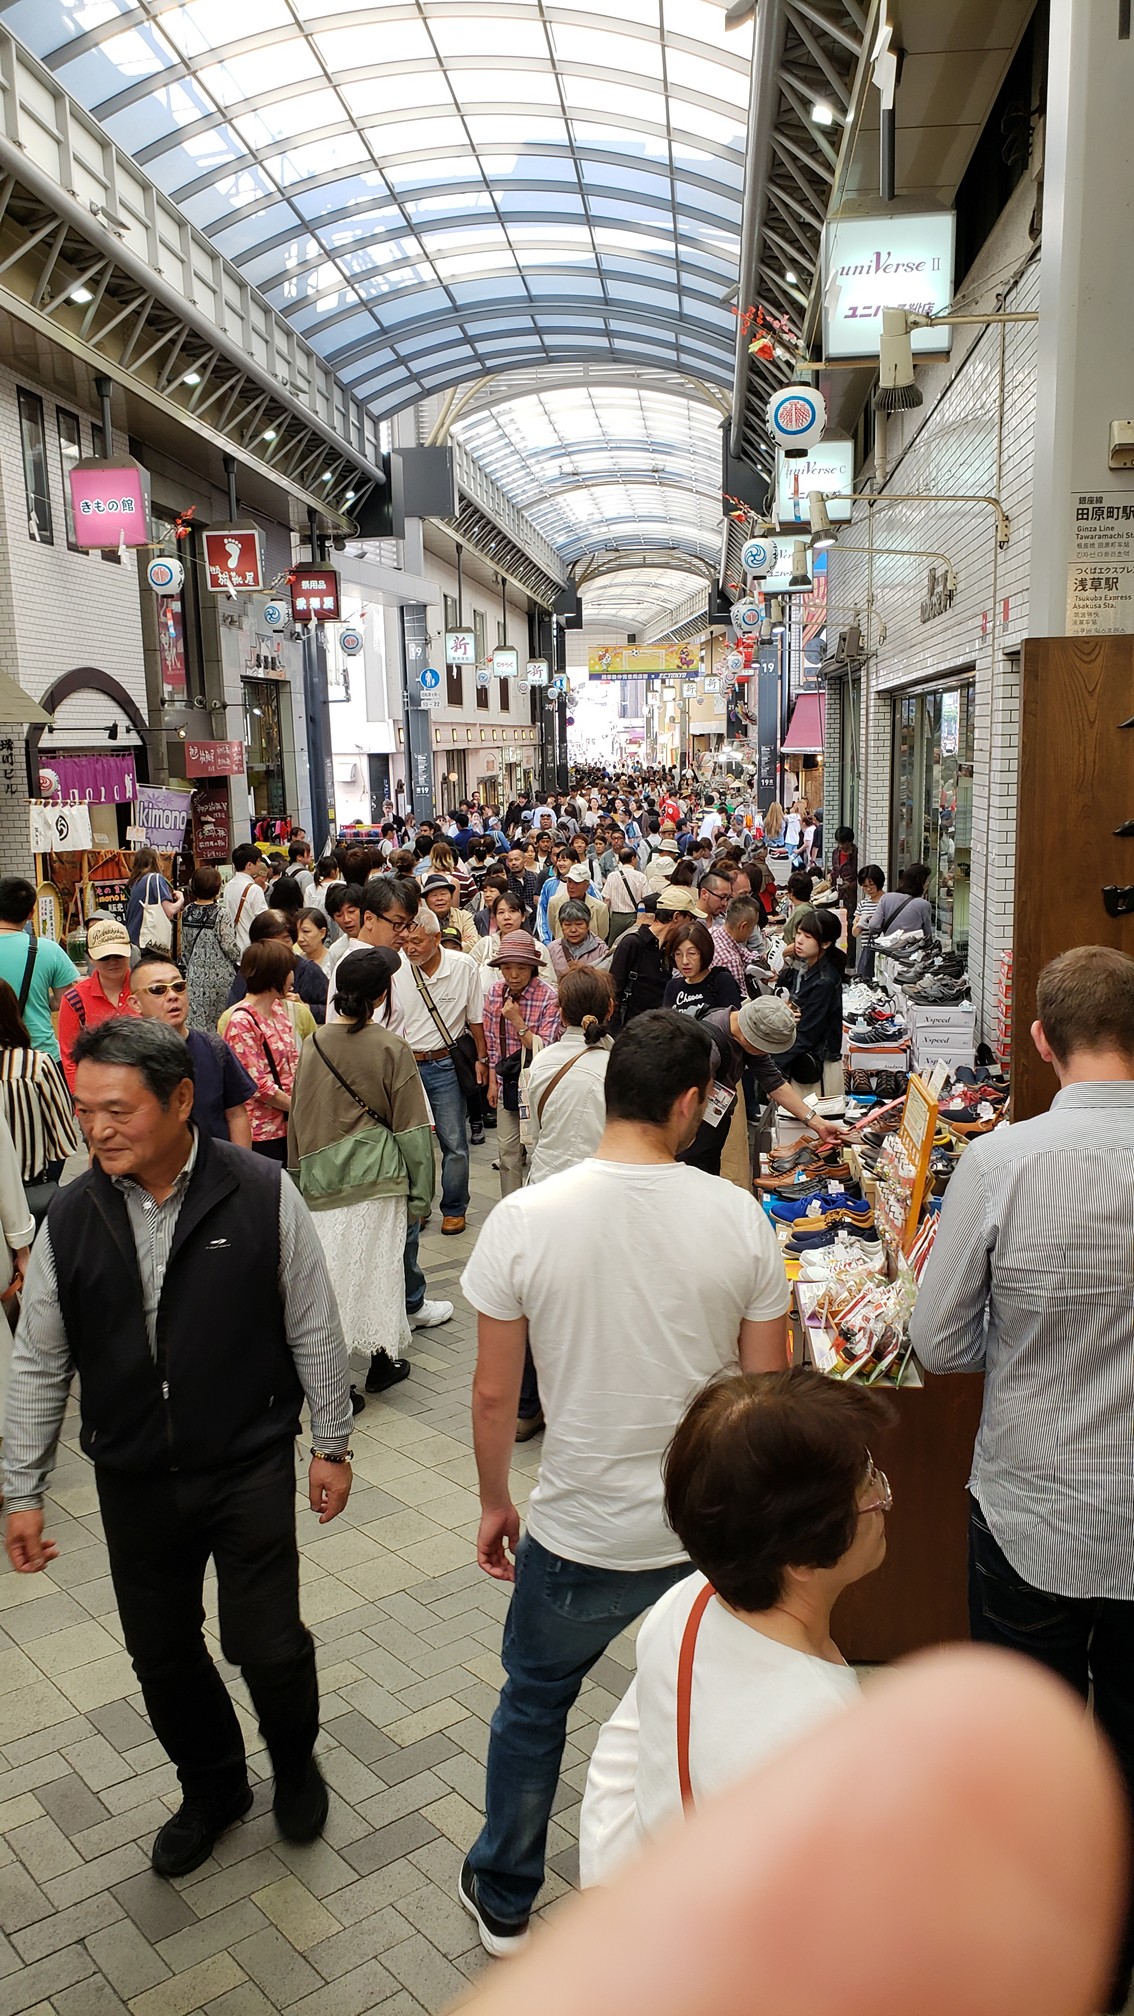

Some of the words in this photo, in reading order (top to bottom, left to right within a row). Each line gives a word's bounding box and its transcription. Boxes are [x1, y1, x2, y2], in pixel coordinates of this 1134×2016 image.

[81, 498, 135, 513] きもの館
[1078, 496, 1104, 505] 銀座線
[1076, 505, 1134, 521] 田原町駅
[1077, 525, 1097, 533] Ginza
[1075, 532, 1124, 540] Tawaramachi
[1073, 577, 1119, 592] 浅草駅
[1104, 594, 1132, 602] Express
[451, 635, 470, 656] 新
[762, 663, 774, 673] 19
[139, 801, 188, 830] kimono
